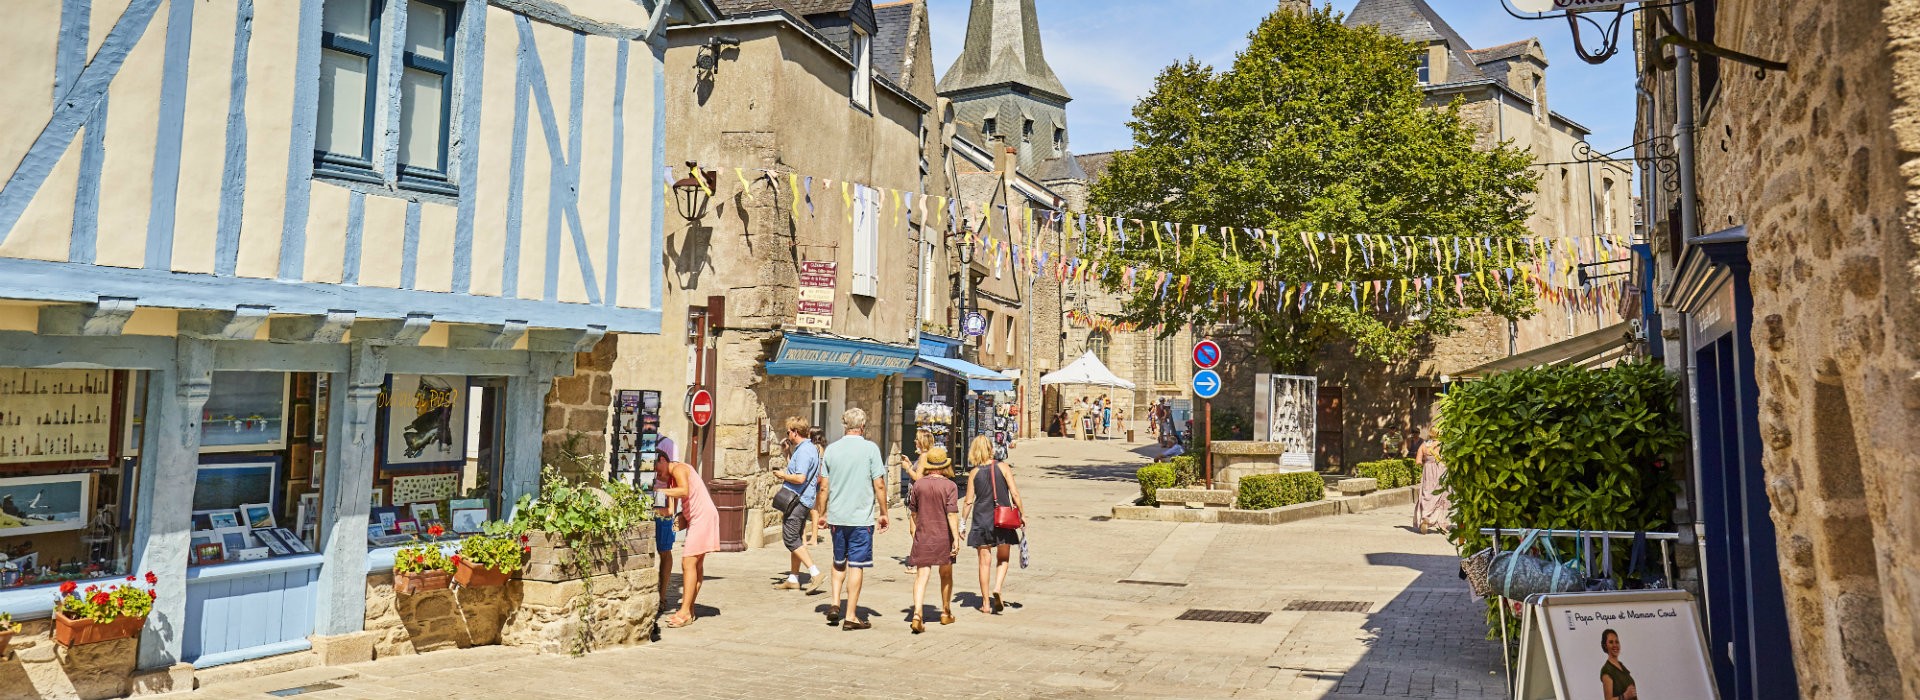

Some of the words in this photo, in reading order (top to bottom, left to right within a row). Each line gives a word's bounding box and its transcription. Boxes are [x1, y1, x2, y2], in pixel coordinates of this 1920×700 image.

[784, 348, 819, 360] PRODUITS
[861, 354, 883, 366] VENTE
[1574, 612, 1594, 626] Papa
[1595, 611, 1617, 625] Pique
[1618, 610, 1626, 620] et
[1627, 609, 1655, 619] Maman
[1657, 608, 1677, 618] Coud
